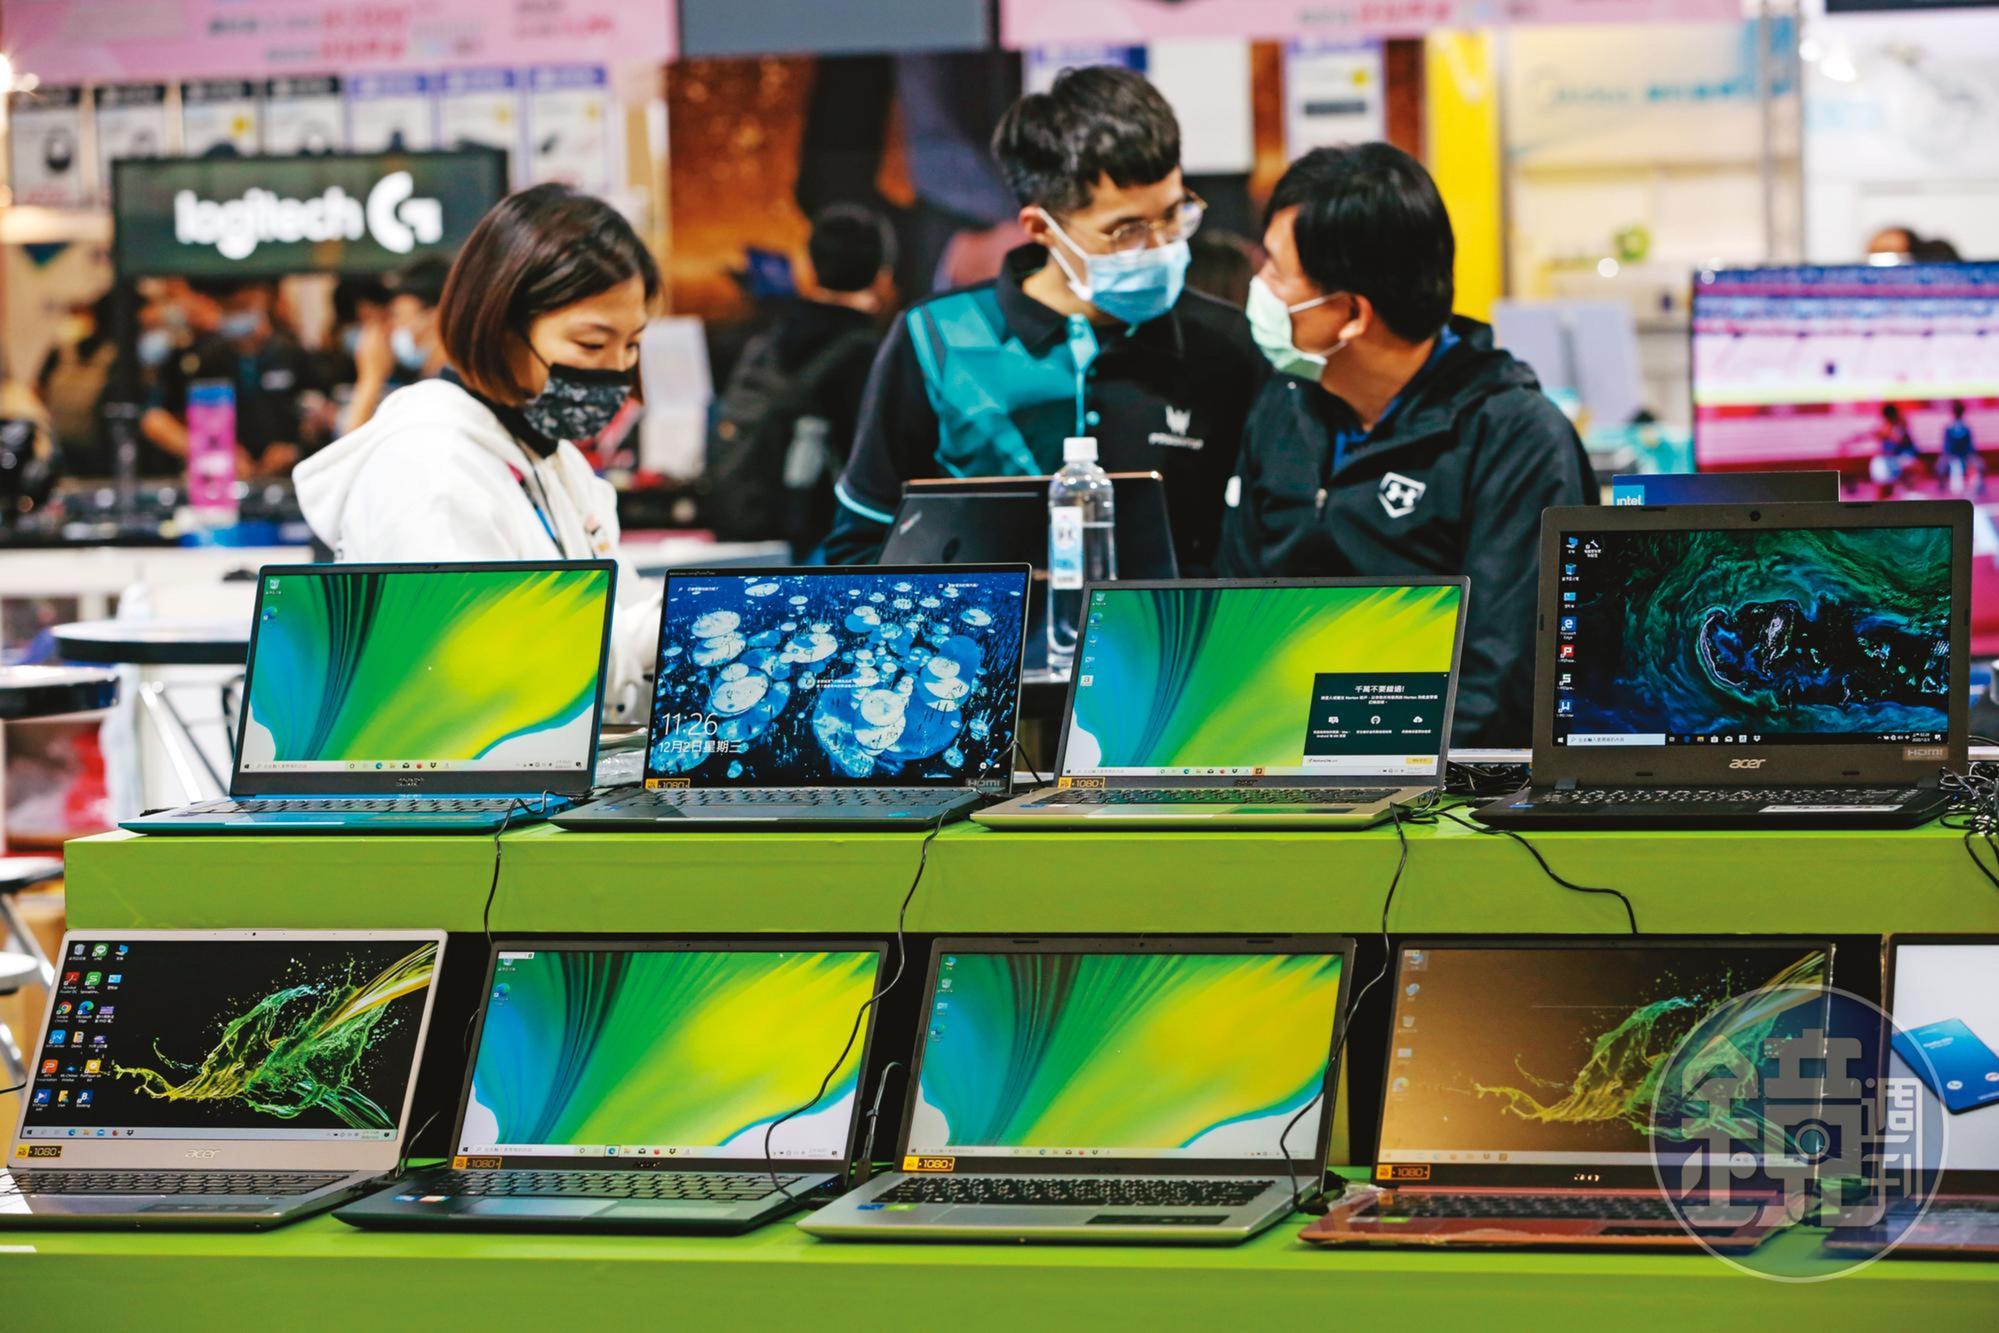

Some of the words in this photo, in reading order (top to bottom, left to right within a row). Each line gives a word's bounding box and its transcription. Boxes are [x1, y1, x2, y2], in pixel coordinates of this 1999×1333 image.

[174, 186, 364, 260] logitech
[662, 712, 718, 736] 11:26
[1729, 759, 1767, 769] acer
[34, 1147, 57, 1156] 1080
[184, 1149, 221, 1159] acer
[923, 1159, 949, 1169] 1080
[1397, 1168, 1424, 1177] 1080
